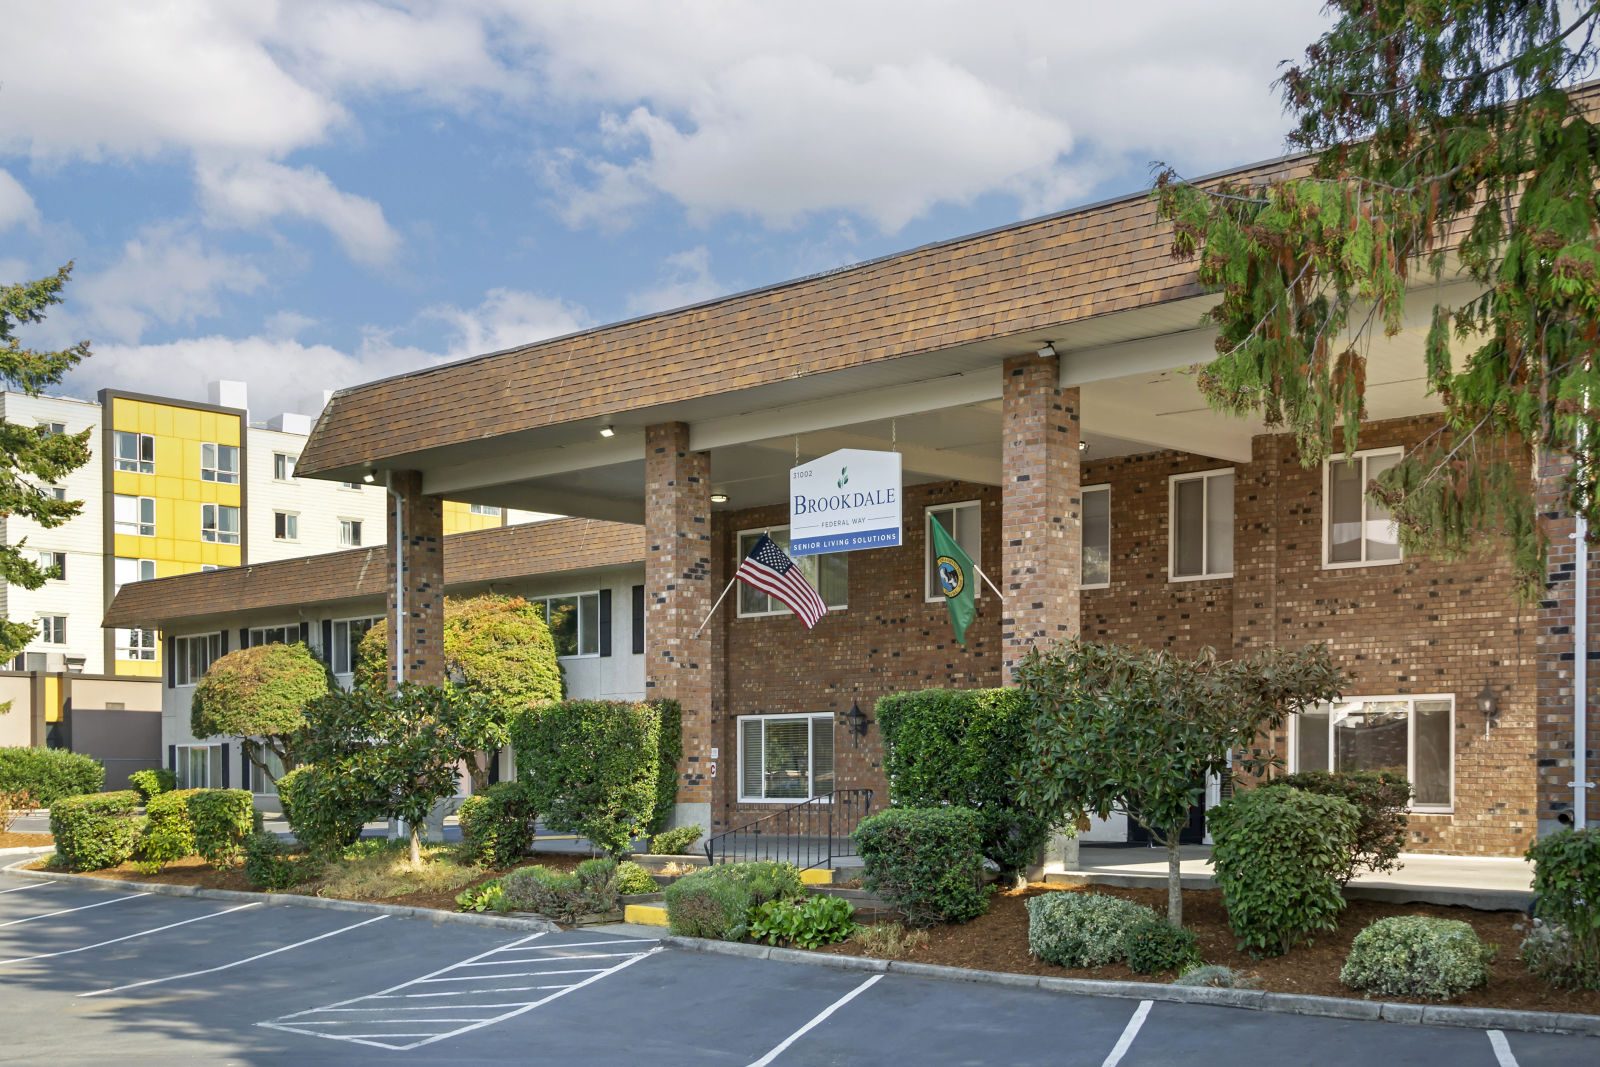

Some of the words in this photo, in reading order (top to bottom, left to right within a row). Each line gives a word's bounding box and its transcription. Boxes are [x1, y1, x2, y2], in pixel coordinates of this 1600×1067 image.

[793, 470, 813, 479] 31002
[794, 488, 896, 516] BROOKDALE
[821, 519, 850, 528] FEDERAL
[851, 517, 866, 525] WAY
[793, 542, 823, 551] SENIOR
[823, 538, 850, 548] LIVING
[852, 533, 897, 545] SOLUTIONS
